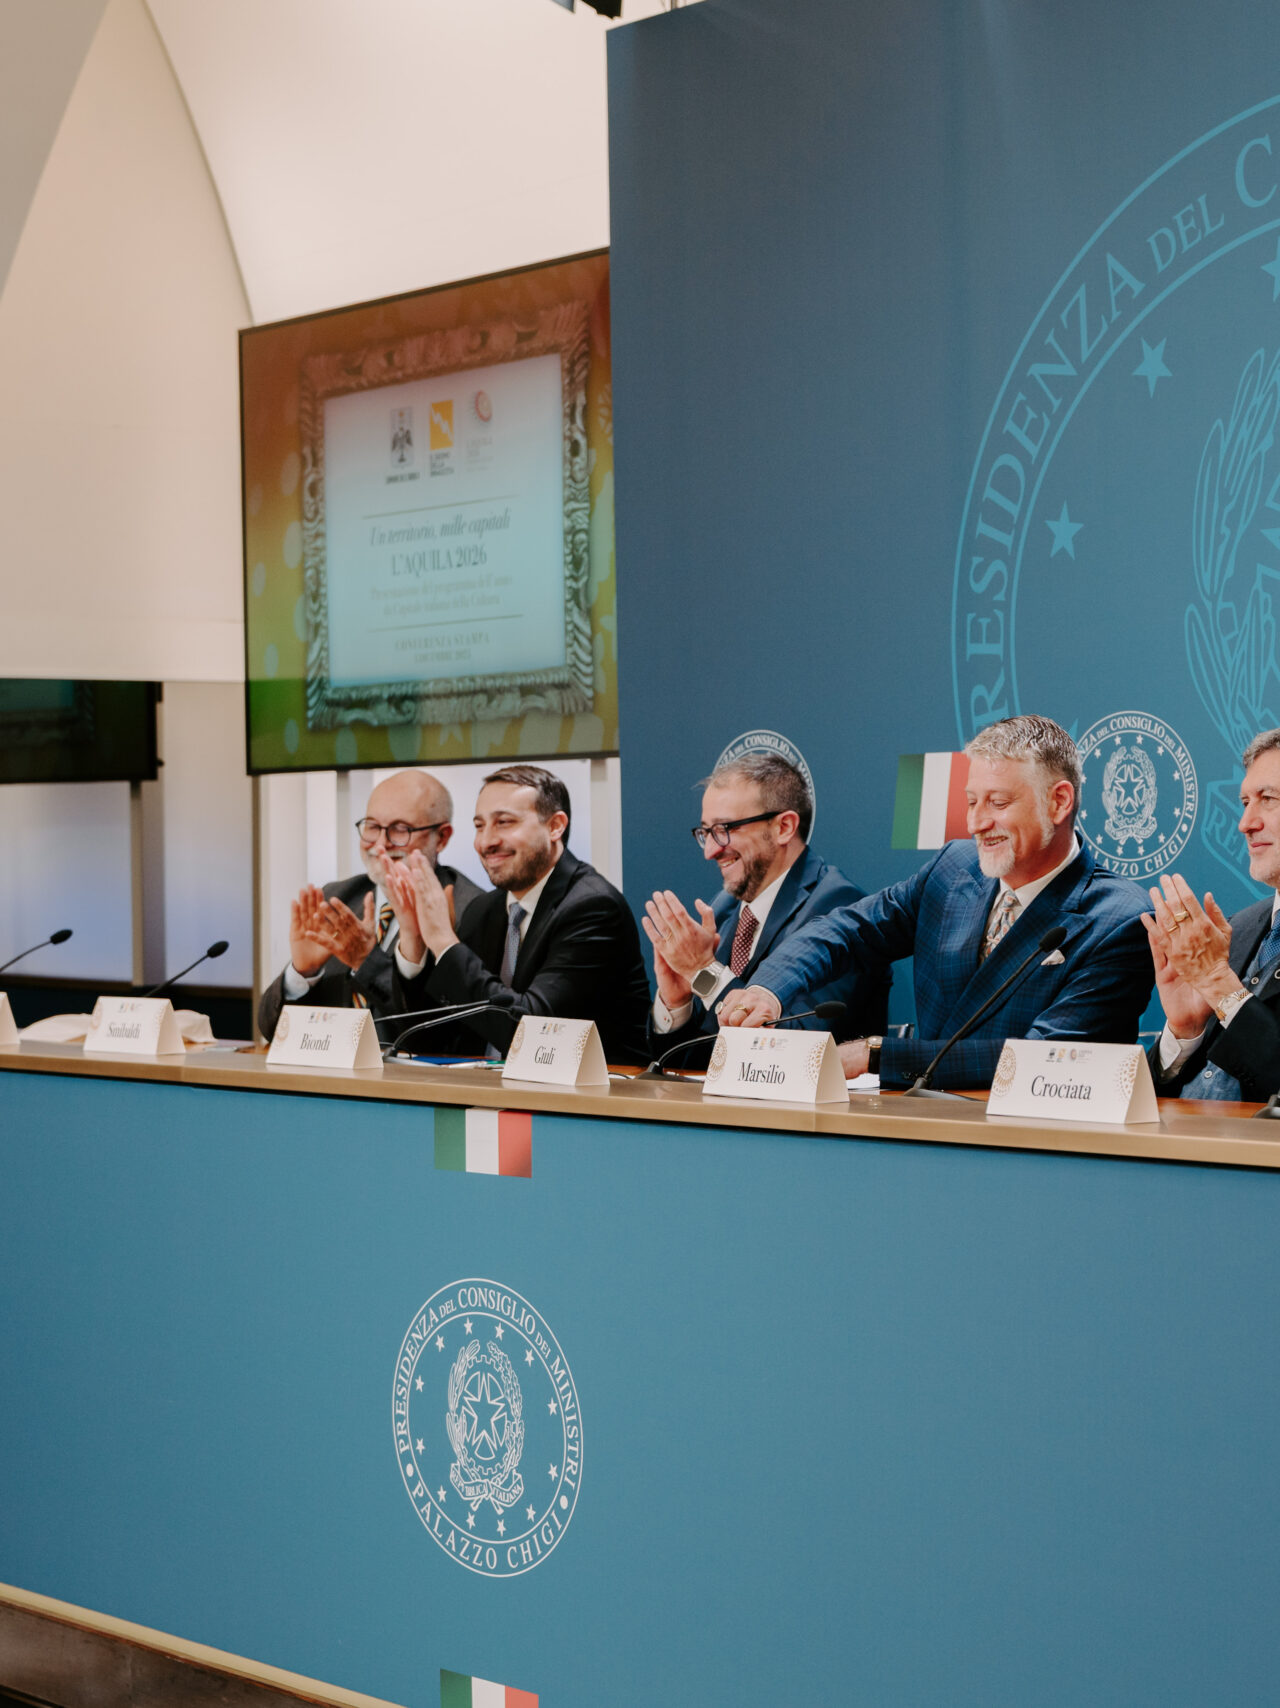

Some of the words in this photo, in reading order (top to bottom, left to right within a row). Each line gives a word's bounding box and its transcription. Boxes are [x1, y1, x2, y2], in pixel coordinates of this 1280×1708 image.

[966, 253, 1146, 736] RESIDENZA
[1147, 194, 1224, 274] DEL
[440, 513, 467, 537] mille
[468, 505, 510, 539] capitali
[455, 544, 488, 568] 2026
[744, 734, 790, 754] CONSIGLIO
[1096, 727, 1110, 739] DEL
[1109, 715, 1166, 738] CONSIGLIO
[1164, 734, 1176, 750] DEI
[1175, 746, 1196, 820] MINISTRI
[1144, 833, 1184, 873] CHIGI
[299, 1033, 331, 1051] Biondi
[534, 1045, 555, 1066] Giuli
[737, 1061, 786, 1085] Marsilio
[1030, 1075, 1092, 1101] Crociata
[395, 1307, 439, 1455] PRESIDENZA
[439, 1299, 457, 1319] DEL
[458, 1287, 536, 1335] CONSIGLIO
[534, 1332, 552, 1360] DEI
[551, 1355, 580, 1490] MINISTRI
[411, 1480, 498, 1570] PALAZZO
[506, 1511, 563, 1569] CHIGI
